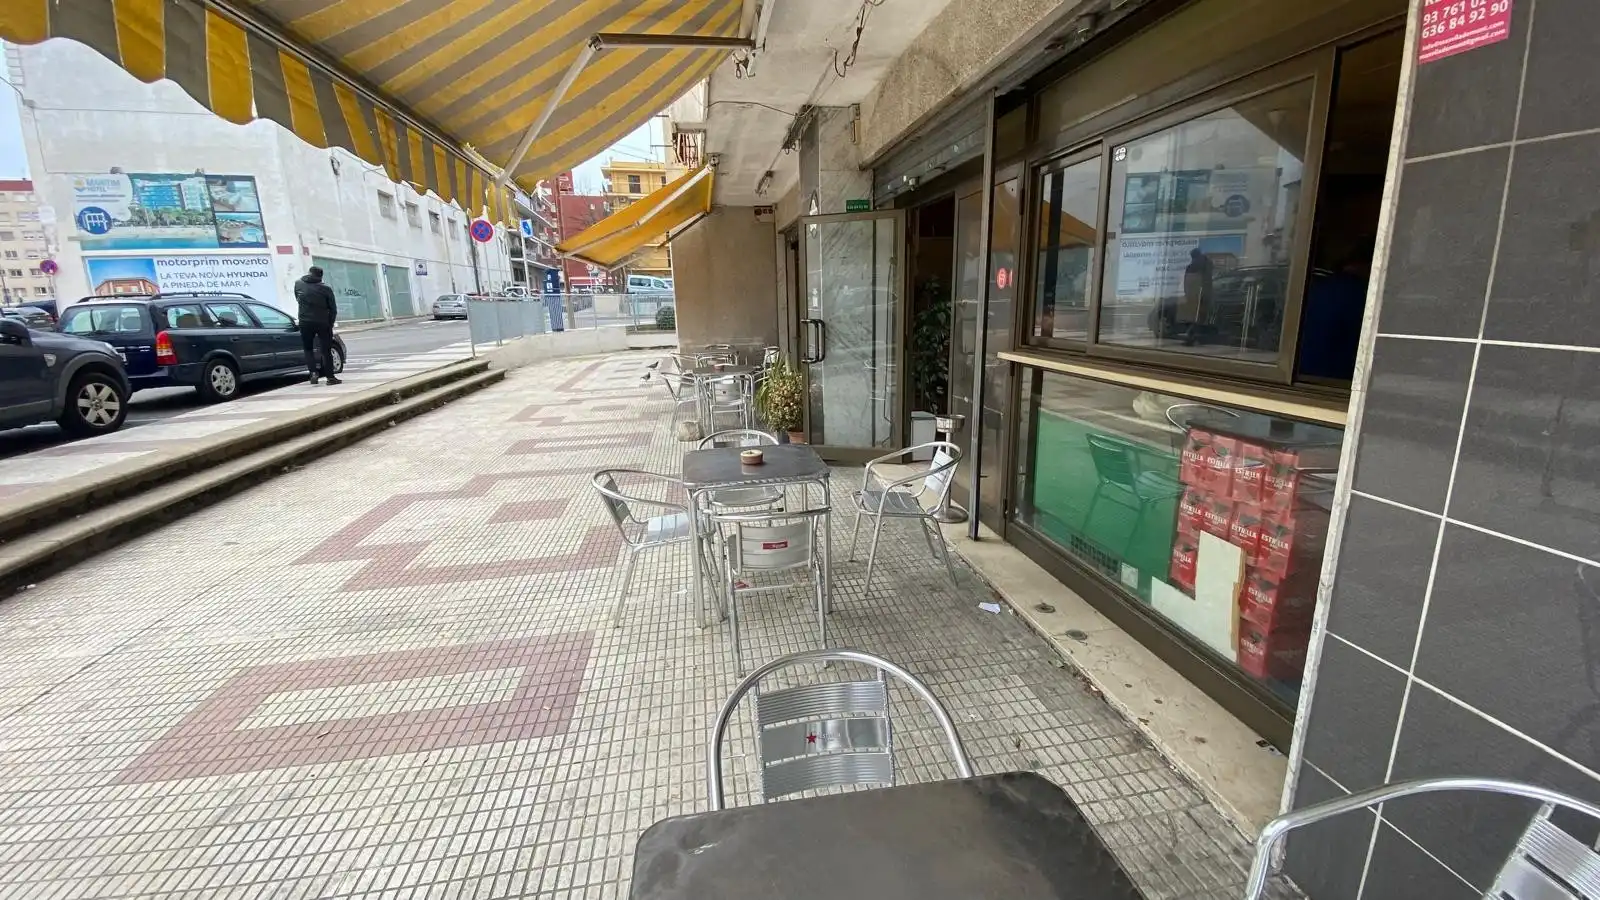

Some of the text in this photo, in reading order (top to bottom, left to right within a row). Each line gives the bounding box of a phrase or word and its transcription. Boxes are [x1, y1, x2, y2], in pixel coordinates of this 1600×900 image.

[1423, 11, 1439, 26] 93
[1442, 2, 1466, 19] 761
[1422, 21, 1446, 39] 636
[1449, 15, 1466, 30] 84
[1468, 7, 1486, 24] 92
[1490, 0, 1509, 16] 90
[157, 258, 220, 268] motorprim
[160, 272, 172, 280] LA
[175, 272, 197, 280] TEVA
[170, 281, 205, 289] PINEDA
[221, 280, 242, 288] MAR
